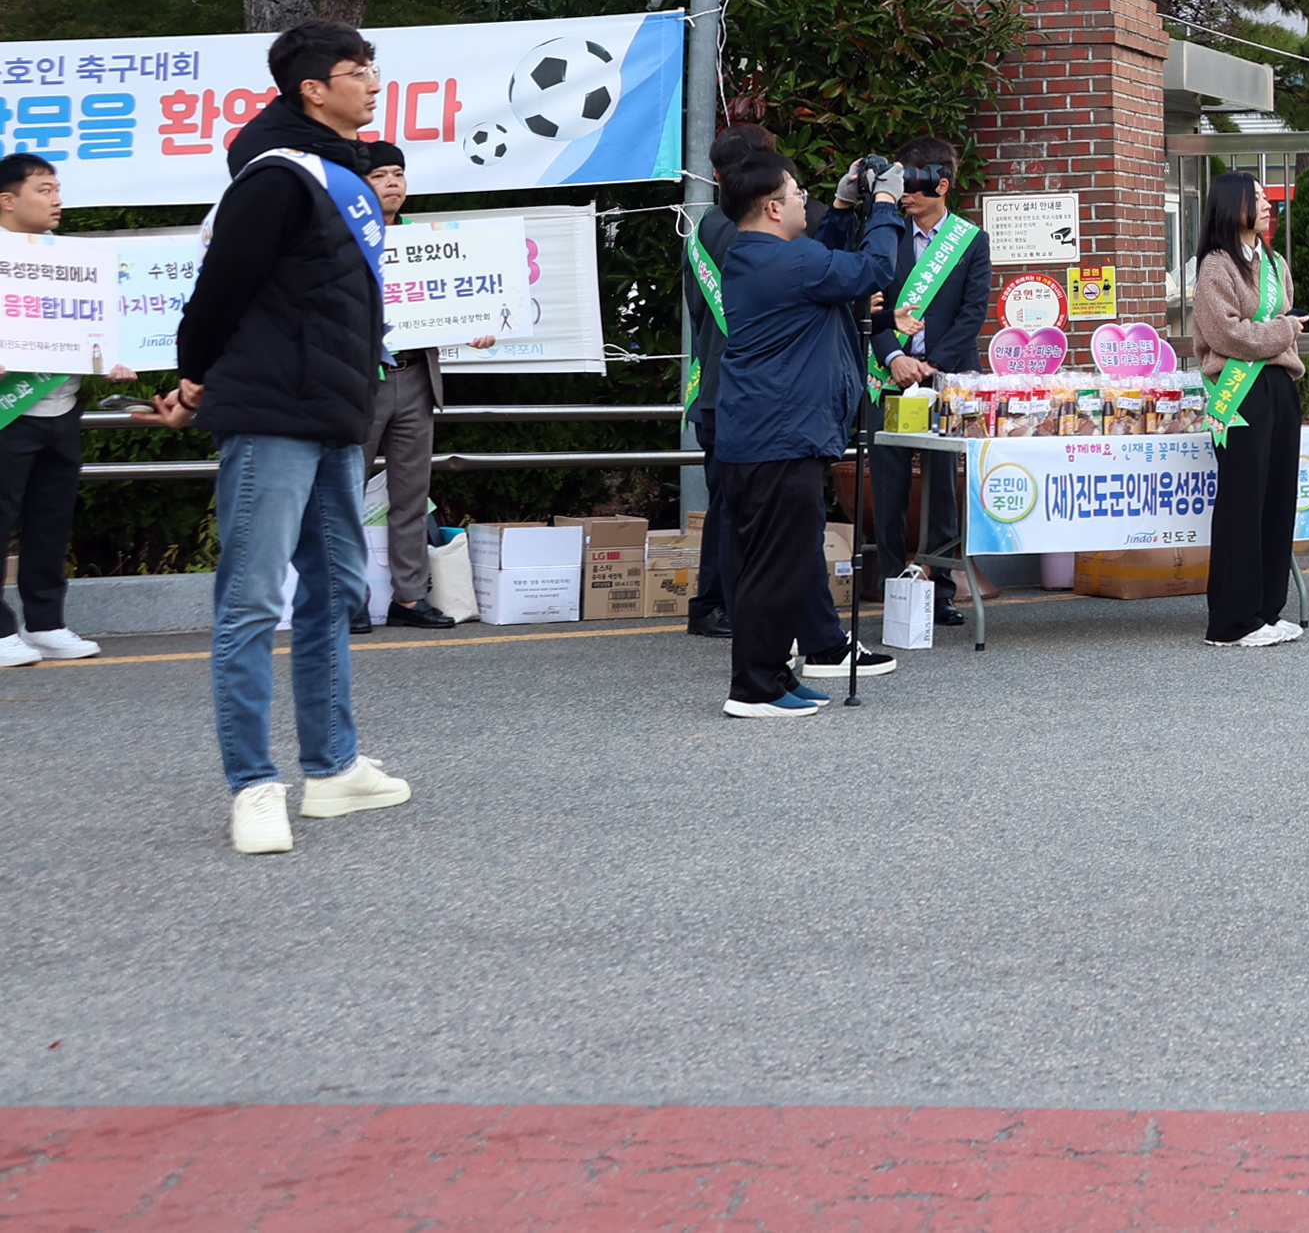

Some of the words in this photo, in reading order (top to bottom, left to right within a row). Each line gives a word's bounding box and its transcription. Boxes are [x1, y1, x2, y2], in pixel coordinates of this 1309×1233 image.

[76, 51, 199, 84] 축구대회
[996, 203, 1020, 212] CCTV
[1022, 202, 1037, 211] 설치
[1040, 201, 1062, 211] 안내문
[406, 242, 467, 263] 많았어,
[148, 261, 195, 280] 수험생
[454, 273, 504, 297] 걷자!
[1012, 289, 1034, 301] 금연
[4, 294, 104, 321] 응원합니다!
[503, 343, 544, 356] 목포시
[996, 345, 1022, 359] 인재를
[1036, 345, 1063, 358] 피우는
[1100, 341, 1118, 353] 인재를
[1120, 340, 1138, 353] 키우는
[1008, 360, 1025, 372] 작은
[1028, 360, 1046, 372] 정성
[1101, 354, 1120, 367] 진도를
[1121, 354, 1139, 366] 키우는
[1214, 366, 1247, 415] 정기후원
[1065, 444, 1117, 462] 함께해요,
[1121, 442, 1155, 461] 인재를
[1158, 442, 1200, 460] 꽃피우는
[988, 478, 1028, 494] 군민이
[992, 495, 1024, 511] 주인!
[1162, 530, 1198, 544] 진도군
[592, 552, 606, 560] LG
